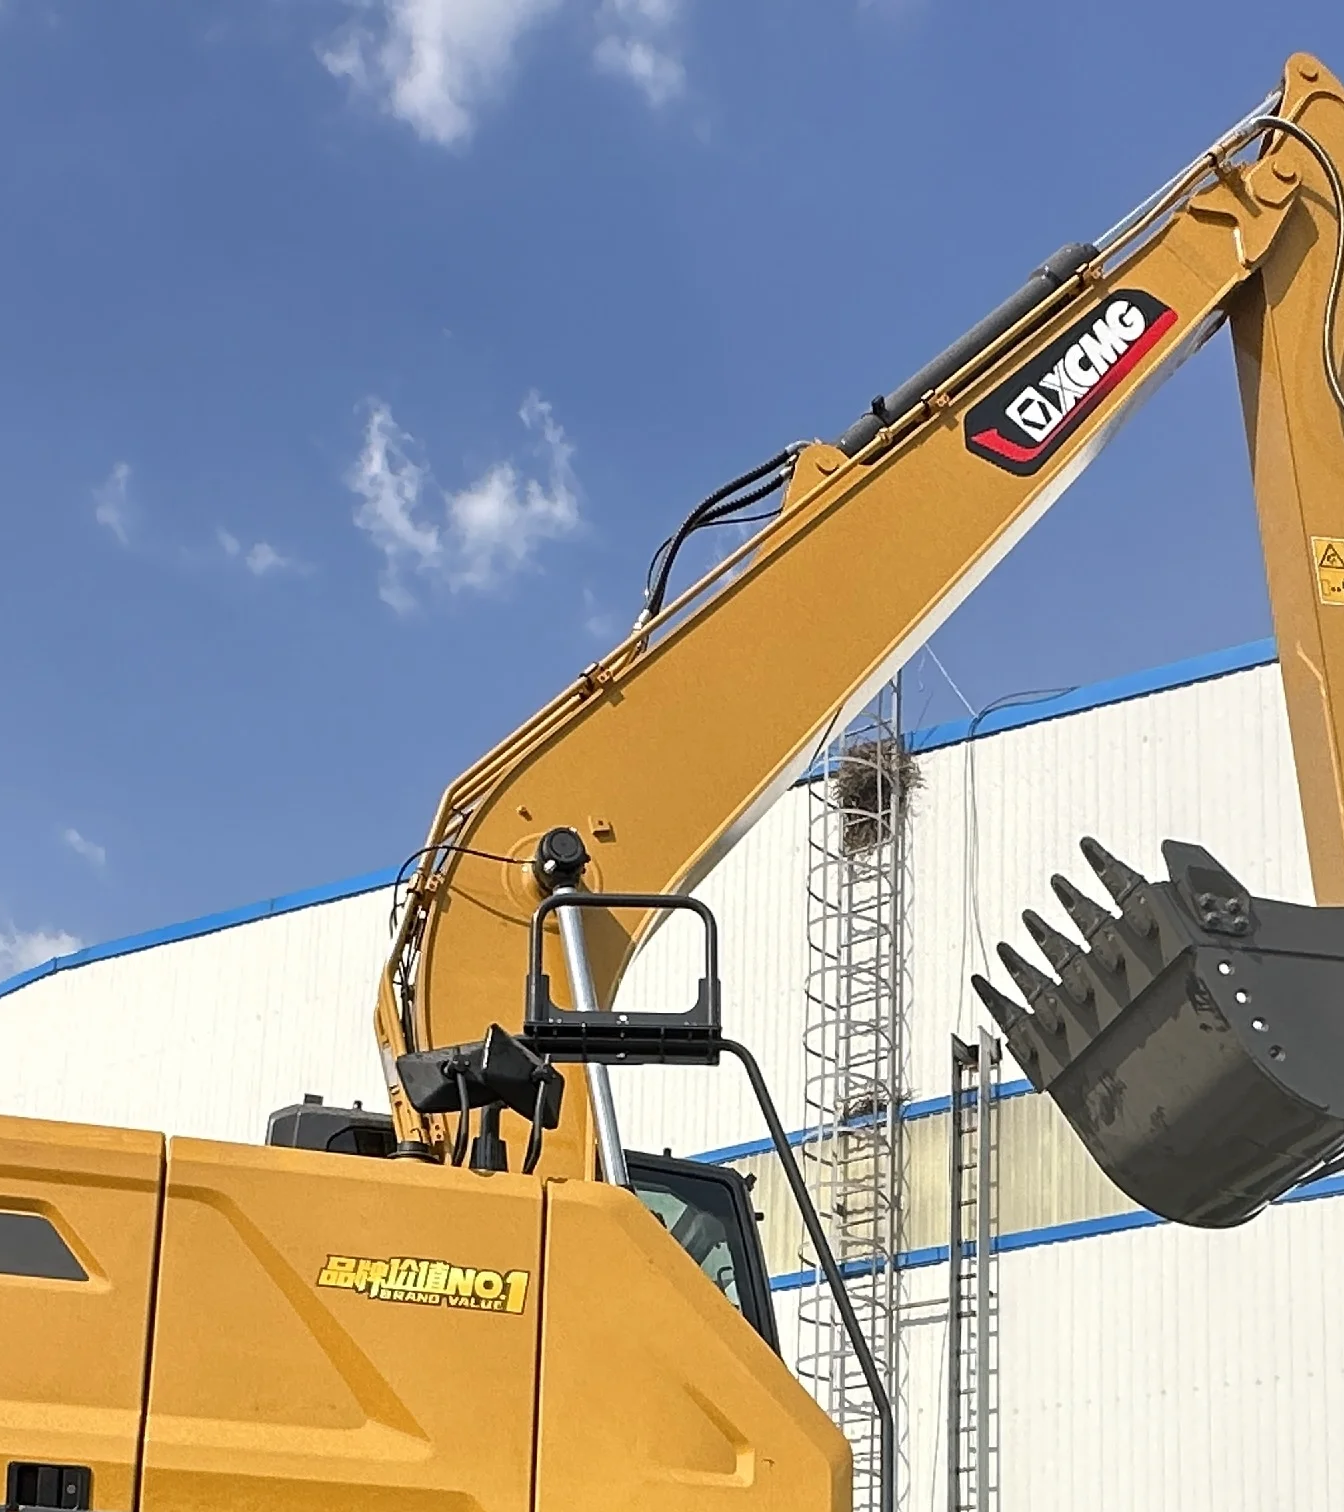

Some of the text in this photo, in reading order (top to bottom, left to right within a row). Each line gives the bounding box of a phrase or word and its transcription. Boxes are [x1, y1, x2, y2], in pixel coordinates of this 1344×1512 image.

[1039, 299, 1147, 415] XCMG
[379, 1288, 505, 1311] BRAND VALUE
